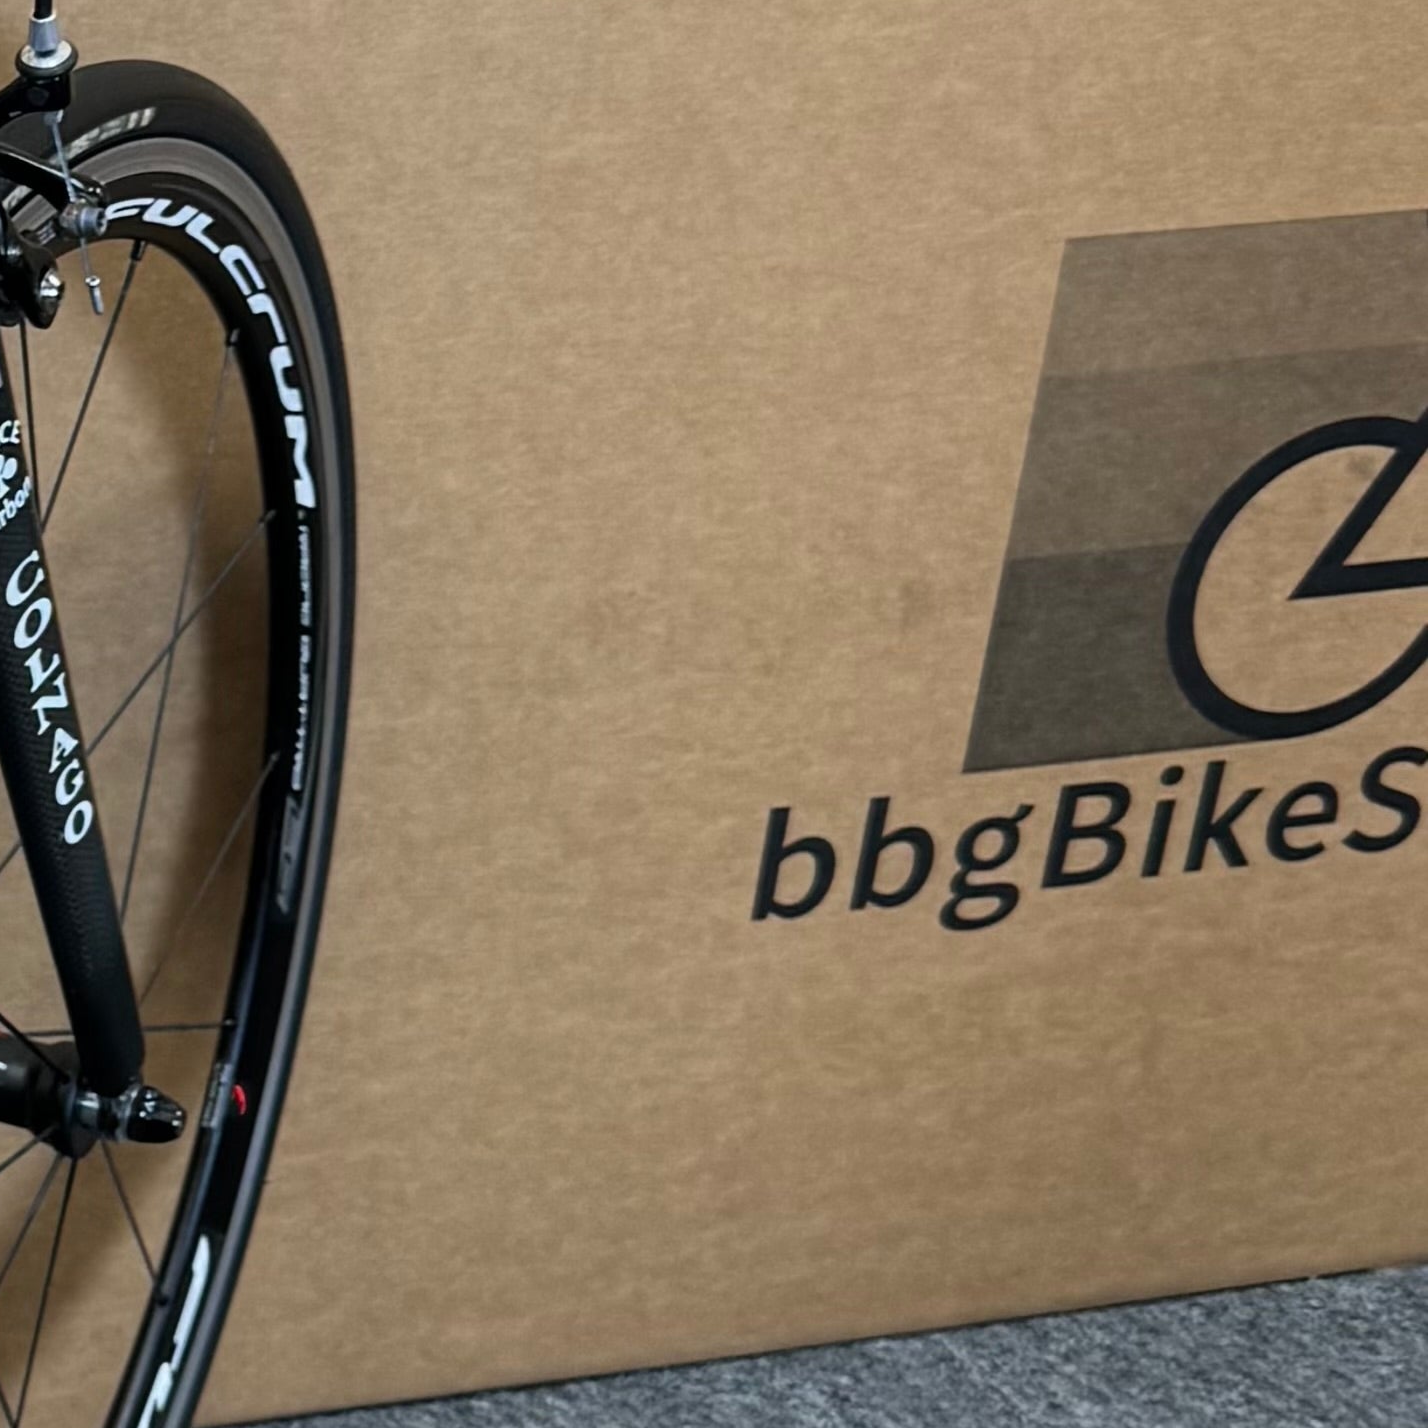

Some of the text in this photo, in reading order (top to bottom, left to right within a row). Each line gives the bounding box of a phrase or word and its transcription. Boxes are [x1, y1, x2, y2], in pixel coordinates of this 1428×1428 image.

[105, 197, 316, 509] FULCRUM
[5, 549, 94, 845] COLNAGO
[752, 742, 1428, 932] bbgBikeS
